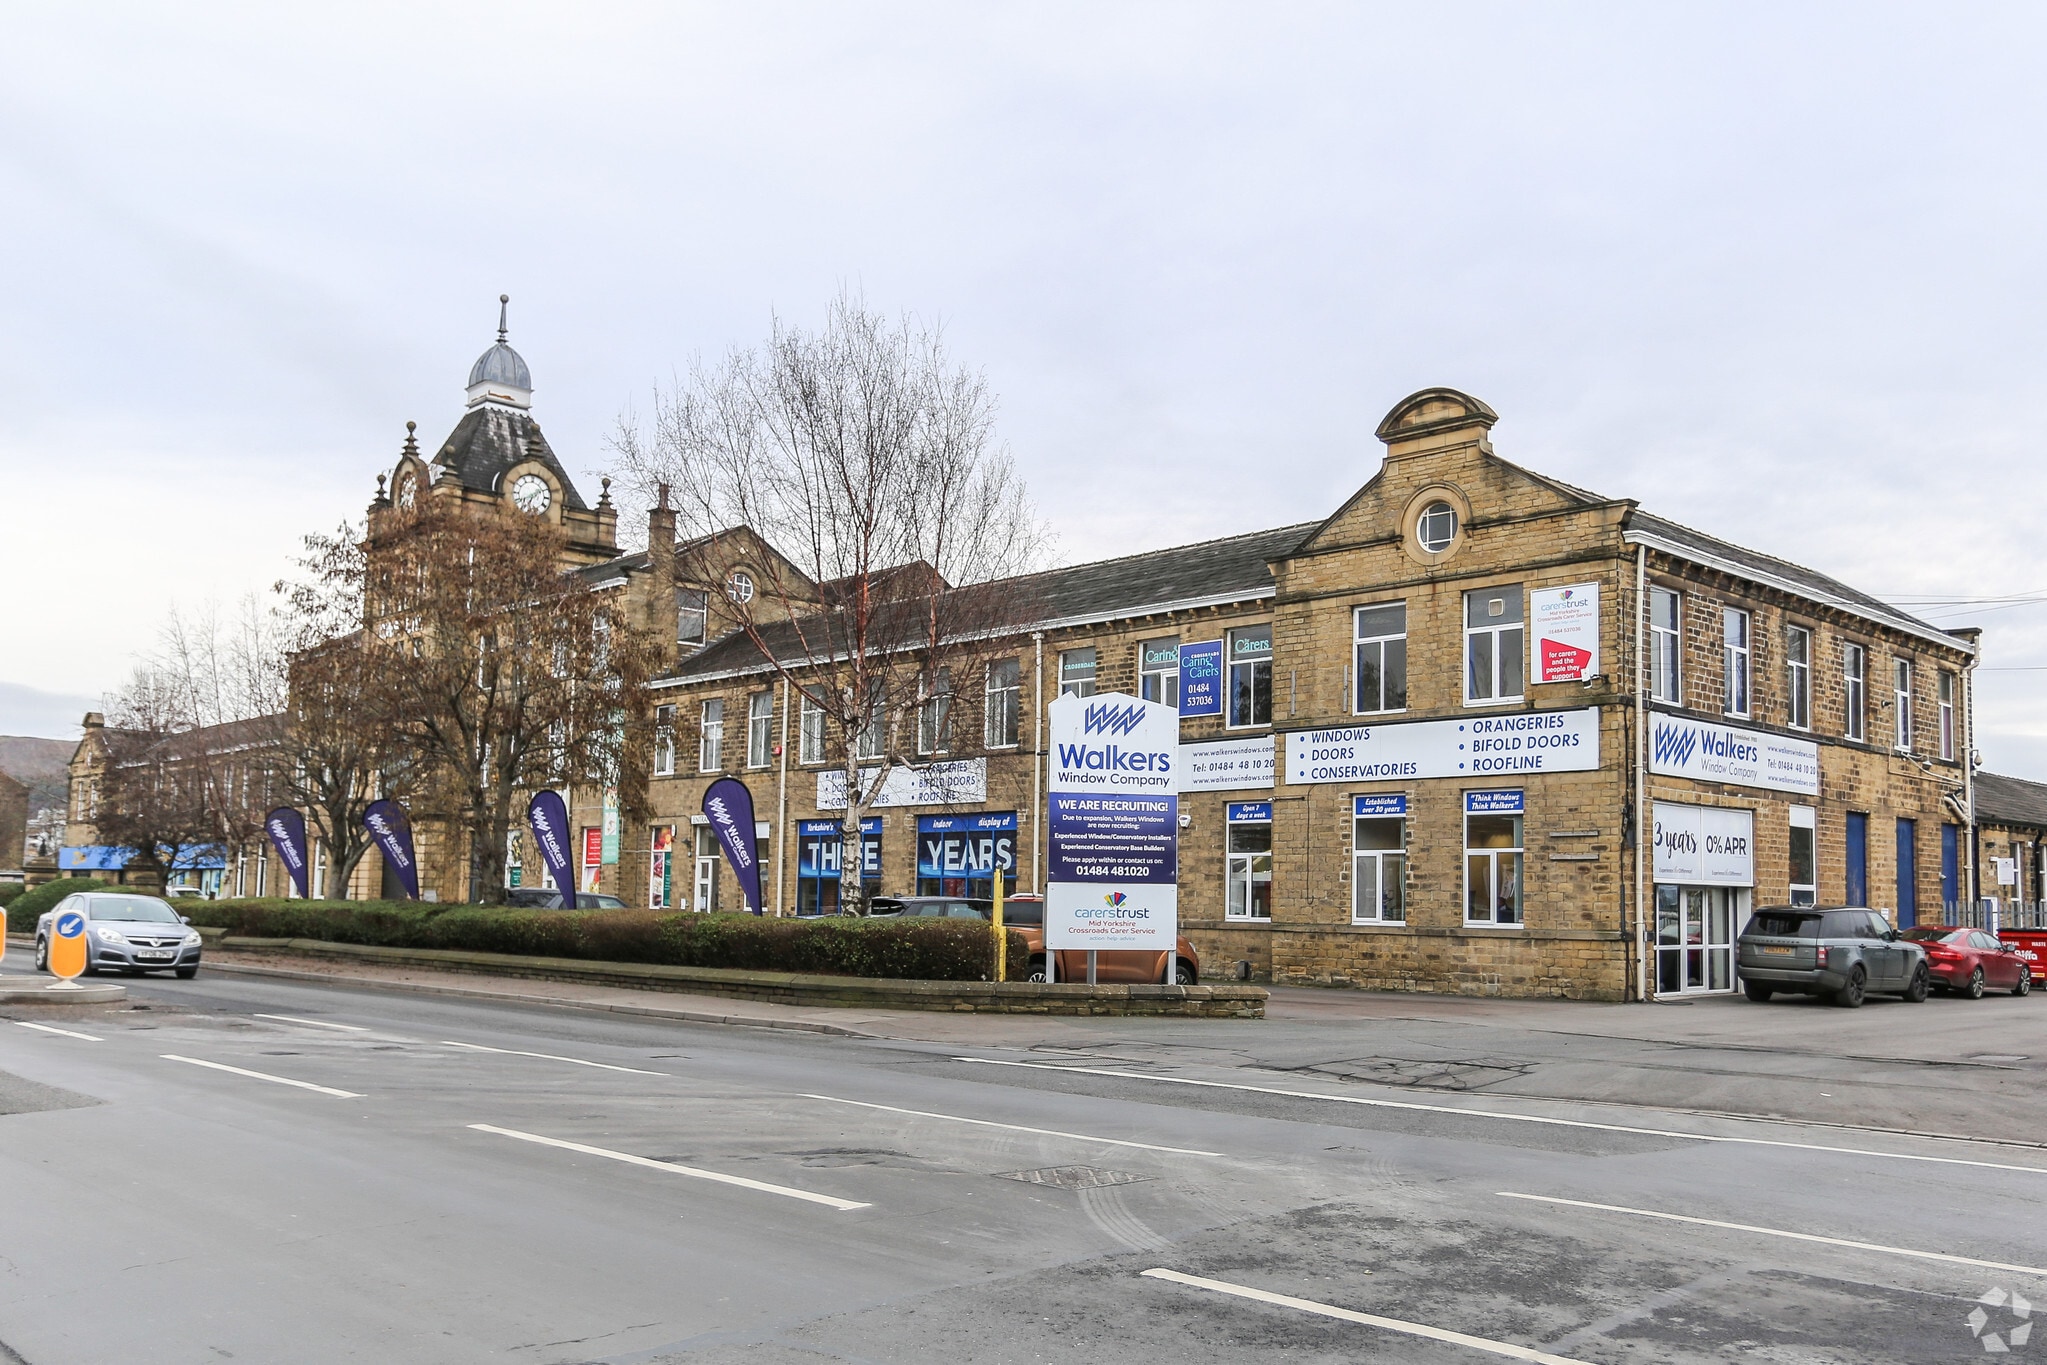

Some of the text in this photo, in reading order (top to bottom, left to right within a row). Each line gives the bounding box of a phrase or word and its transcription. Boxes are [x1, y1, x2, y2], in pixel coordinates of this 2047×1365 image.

[1235, 639, 1269, 653] Carers
[1145, 645, 1178, 663] Caring
[1182, 655, 1213, 668] Caring
[1190, 667, 1219, 678] Carers
[1546, 666, 1566, 674] people
[1188, 683, 1209, 694] 01484
[1187, 695, 1213, 706] 537036
[1473, 715, 1564, 733] ORANGERIES
[1311, 728, 1370, 743] WINDOWS
[1473, 733, 1579, 752] BIFOLD DOORS
[1193, 746, 1275, 757] www.walkerswindows.com
[1701, 729, 1757, 762] Walkers
[1058, 743, 1170, 772] Walkers
[1311, 747, 1354, 761] DOORS
[1193, 759, 1275, 772] Tel: 01484 48 10 20
[1473, 755, 1543, 771] ROOFLINE
[1701, 757, 1757, 782] Window Company
[1768, 759, 1815, 775] Tel: 01484 48 10 20
[1311, 762, 1417, 779] CONSERVATORIES
[947, 775, 975, 787] DOORS
[1058, 772, 1170, 788] Window Company
[1193, 774, 1275, 784] www.walkerswindows.com
[1365, 797, 1398, 805] Established
[1493, 793, 1520, 801] Windows
[1058, 800, 1169, 812] WE ARE RECRUITING!
[1384, 806, 1400, 814] years
[1472, 802, 1488, 810] Think
[807, 822, 834, 831] Yorkshire's
[932, 816, 1010, 828] indoor display of
[1054, 832, 1087, 840] Experienced
[1088, 833, 1147, 841] Window/Conservatory
[1654, 821, 1697, 859] 3 years
[387, 834, 409, 866] Walkers
[545, 830, 566, 867] Walkers
[728, 824, 751, 866] Walkers
[1094, 844, 1129, 852] Conservatory
[1706, 835, 1747, 855] 0% APR
[284, 838, 302, 867] Walkers
[808, 842, 878, 871] THE
[926, 838, 1012, 871] YEARS
[1076, 866, 1150, 877] 01484 481020
[1074, 908, 1149, 919] carerstrust
